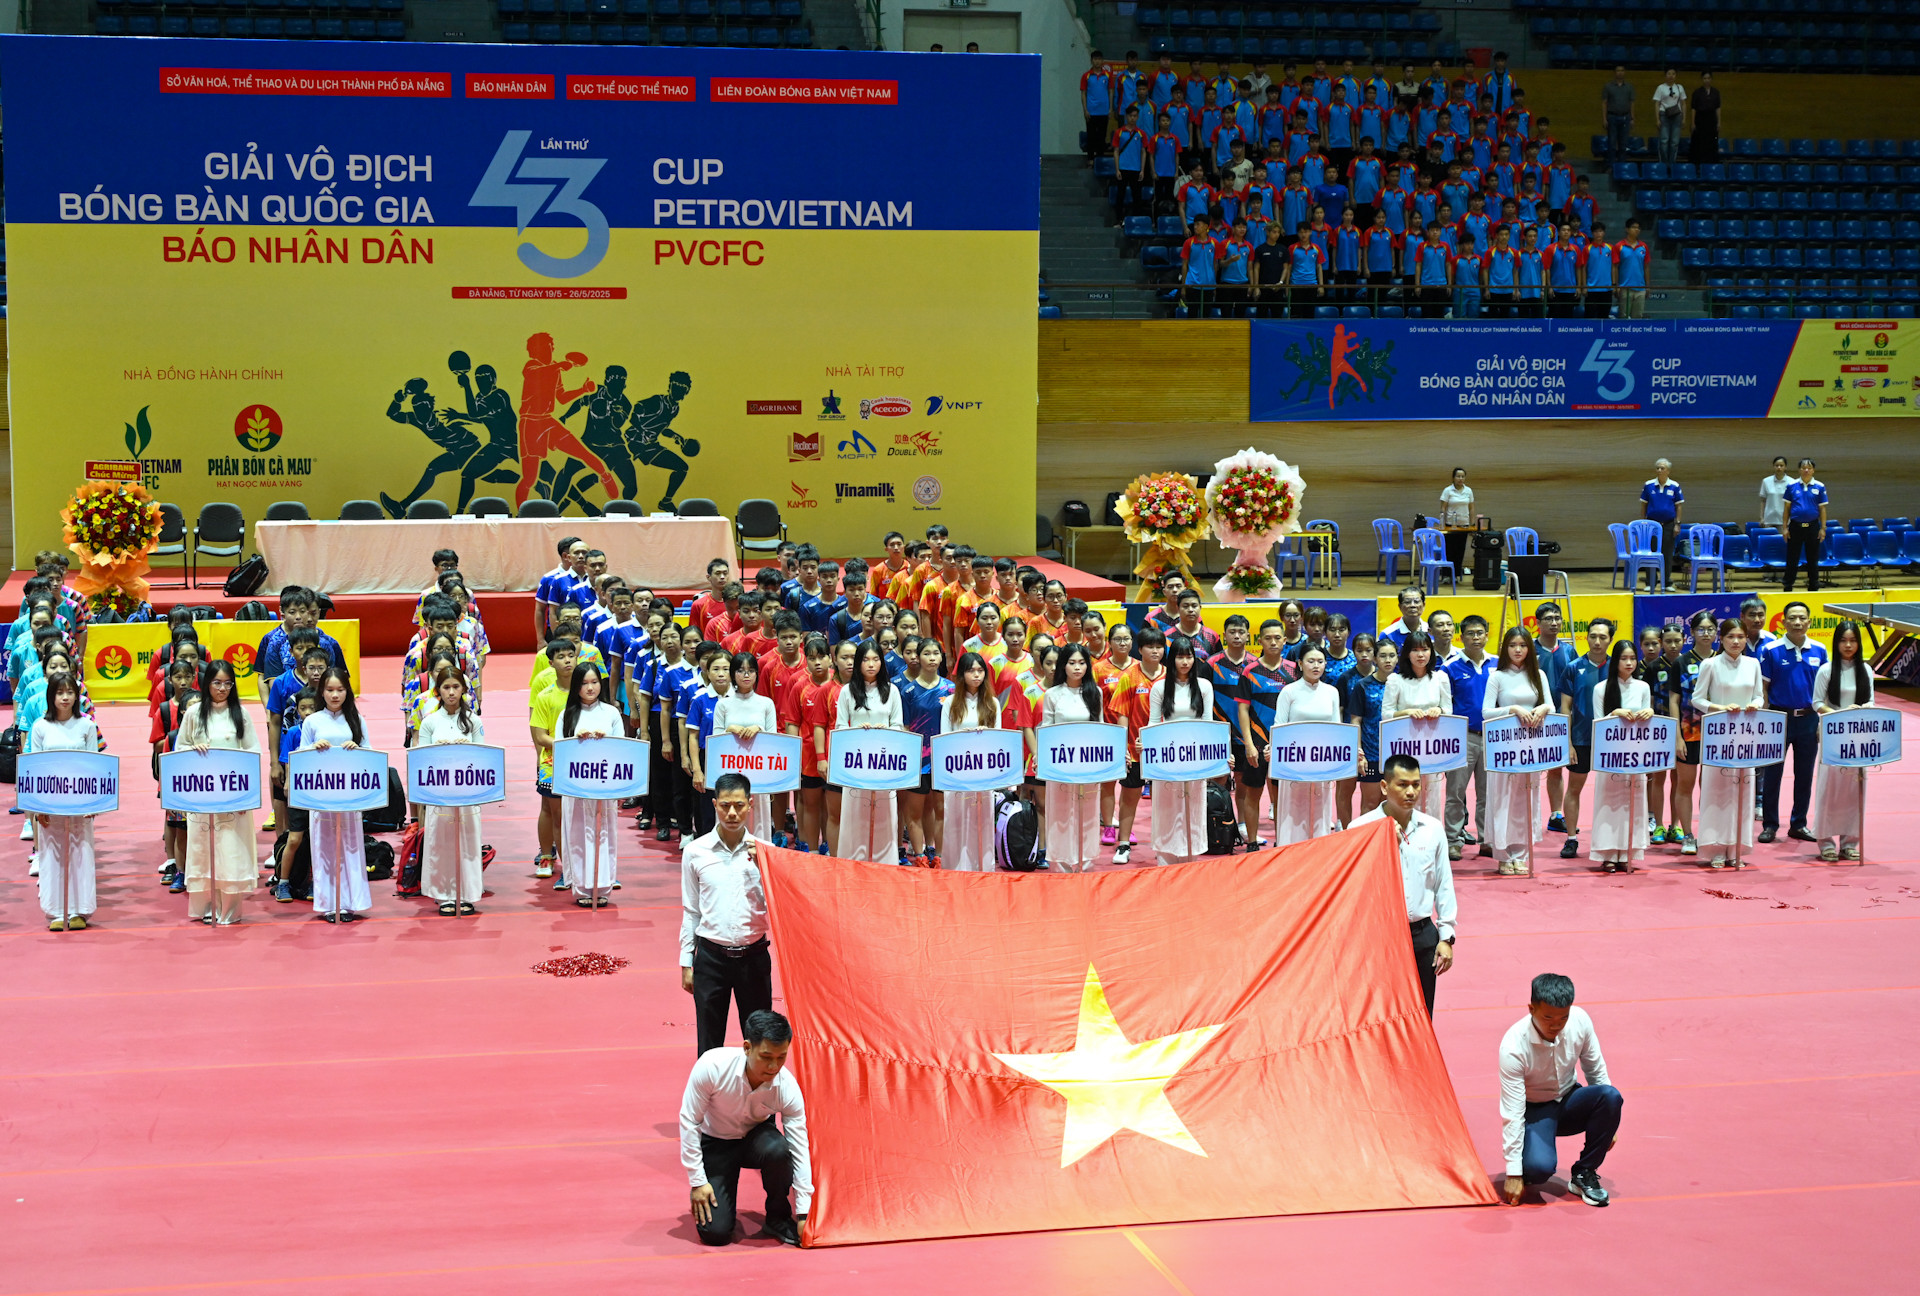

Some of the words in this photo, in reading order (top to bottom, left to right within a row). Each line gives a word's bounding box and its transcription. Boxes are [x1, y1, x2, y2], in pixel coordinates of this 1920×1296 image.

[166, 74, 182, 87] SỞ
[183, 76, 204, 87] VĂN
[206, 76, 230, 89] HOÁ,
[232, 74, 253, 88] THỂ
[255, 78, 283, 89] THAO
[284, 76, 298, 89] VÀ
[300, 79, 314, 89] DU
[317, 79, 339, 91] LỊCH
[342, 77, 375, 90] THÀNH
[378, 77, 399, 91] PHỐ
[400, 78, 414, 91] ĐÀ
[416, 77, 444, 91] NẴNG
[474, 80, 495, 92] BÁO
[496, 81, 524, 93] NHÂN
[526, 81, 547, 93] DÂN
[574, 84, 595, 96] CỤC
[596, 80, 617, 95] THỂ
[618, 84, 639, 97] DỤC
[640, 81, 660, 95] THỂ
[662, 85, 689, 96] THAO
[718, 84, 742, 97] LIÊN
[745, 84, 777, 97] ĐOÀN
[779, 85, 811, 98] BÓNG
[814, 85, 837, 98] BÀN
[840, 85, 865, 100] VIỆT
[866, 88, 891, 99] NAM
[540, 138, 563, 150] LẦN
[564, 138, 589, 151] THỨ
[204, 142, 273, 181] GIẢI
[286, 145, 335, 182] VÔ
[346, 154, 432, 189] ĐỊCH
[653, 158, 724, 185] CUP
[60, 184, 163, 222] BÓNG
[175, 185, 249, 222] BÀN
[261, 182, 364, 224] QUỐC
[374, 195, 435, 224] GIA
[654, 199, 913, 227] PETROVIETNAM
[162, 228, 236, 264] BÁO
[248, 228, 349, 264] NHÂN
[362, 229, 434, 265] DÂN
[655, 240, 765, 266] PVCFC
[468, 288, 481, 297] ĐÀ
[509, 288, 522, 298] TỪ
[522, 288, 543, 298] NGÀY
[545, 290, 562, 298] 19/5
[569, 290, 611, 298] 26/5/2025
[124, 366, 152, 380] NHÀ
[157, 366, 196, 381] ĐỒNG
[200, 366, 237, 381] HÀNH
[242, 366, 283, 381] CHÍNH
[826, 364, 852, 377] NHÀ
[856, 364, 875, 377] TÀI
[878, 366, 905, 379] TRỢ
[1476, 354, 1504, 371] GIẢI
[1507, 355, 1528, 371] VÔ
[1532, 358, 1566, 374] ĐỊCH
[1652, 358, 1681, 371] CUP
[1420, 373, 1461, 388] BÓNG
[1465, 373, 1493, 388] BÀN
[1498, 371, 1538, 389] QUỐC
[1542, 376, 1566, 388] GIA
[1652, 374, 1757, 388] PETROVIETNAM
[946, 402, 983, 410] VNPT
[1459, 390, 1488, 406] BÁO
[1492, 390, 1532, 406] NHÂN
[1536, 390, 1565, 405] DÂN
[1652, 392, 1697, 405] PVCFC
[90, 470, 110, 478] Chúc
[93, 464, 135, 472] AGRIBANK
[208, 456, 239, 476] PHÂN
[242, 456, 263, 476] BÓN
[268, 455, 284, 476] CÀ
[288, 458, 311, 475] MAU
[216, 480, 231, 489] HẠT
[233, 480, 258, 490] NGỌC
[260, 479, 277, 489] MÙA
[279, 479, 303, 488] VÀNG
[835, 483, 895, 497] Vinamilk
[788, 500, 818, 509] KAMITO
[1892, 640, 1919, 680] SPORT
[1488, 730, 1500, 743] CLB
[1501, 729, 1512, 744] ĐẠI
[1514, 727, 1527, 744] HỌC
[1545, 722, 1567, 737] DƯƠNG
[1605, 726, 1626, 741] CÂU
[1630, 726, 1650, 744] LẠC
[1653, 724, 1667, 744] BỘ
[1708, 722, 1726, 736] CLB
[1729, 722, 1737, 735] P.
[1740, 722, 1755, 736] 14,
[1758, 722, 1768, 735] Q.
[1771, 721, 1783, 734] 10
[1826, 722, 1845, 734] CLB
[1848, 718, 1879, 734] TRÀNG
[1882, 720, 1896, 733] AN
[1050, 744, 1076, 764] TÂY
[1080, 746, 1114, 763] NINH
[1144, 747, 1159, 764] TP.
[1162, 740, 1179, 764] HỒ
[1182, 740, 1197, 762] CHÍ
[1200, 744, 1228, 761] MINH
[1276, 740, 1306, 763] TIỀN
[1310, 746, 1351, 763] GIANG
[1390, 738, 1421, 756] VĨNH
[1426, 738, 1460, 756] LONG
[1494, 752, 1516, 768] PPP
[1520, 746, 1535, 766] CÀ
[1538, 748, 1562, 765] MAU
[1706, 744, 1718, 760] TP.
[1722, 740, 1735, 760] HỒ
[1738, 740, 1753, 760] CHÍ
[1756, 743, 1782, 760] MINH
[1840, 740, 1857, 759] HÀ
[1860, 740, 1881, 762] NỘI
[720, 754, 763, 773] TRỌNG
[768, 750, 788, 771] TÀI
[844, 748, 863, 769] ĐÀ
[868, 747, 907, 771] NẴNG
[945, 750, 984, 772] QUÂN
[988, 748, 1011, 773] ĐỘI
[1600, 752, 1639, 768] TIMES
[1642, 751, 1671, 768] CITY
[172, 772, 215, 793] HƯNG
[221, 770, 249, 792] YÊN
[294, 769, 346, 791] KHÁNH
[350, 768, 381, 790] HÒA
[418, 764, 450, 787] LÂM
[454, 763, 496, 787] ĐỒNG
[569, 759, 609, 784] NGHỆ
[613, 762, 634, 781] AN
[18, 770, 34, 794] HẢI
[37, 775, 98, 795] DƯƠNG-LONG
[100, 772, 116, 795] HẢI
